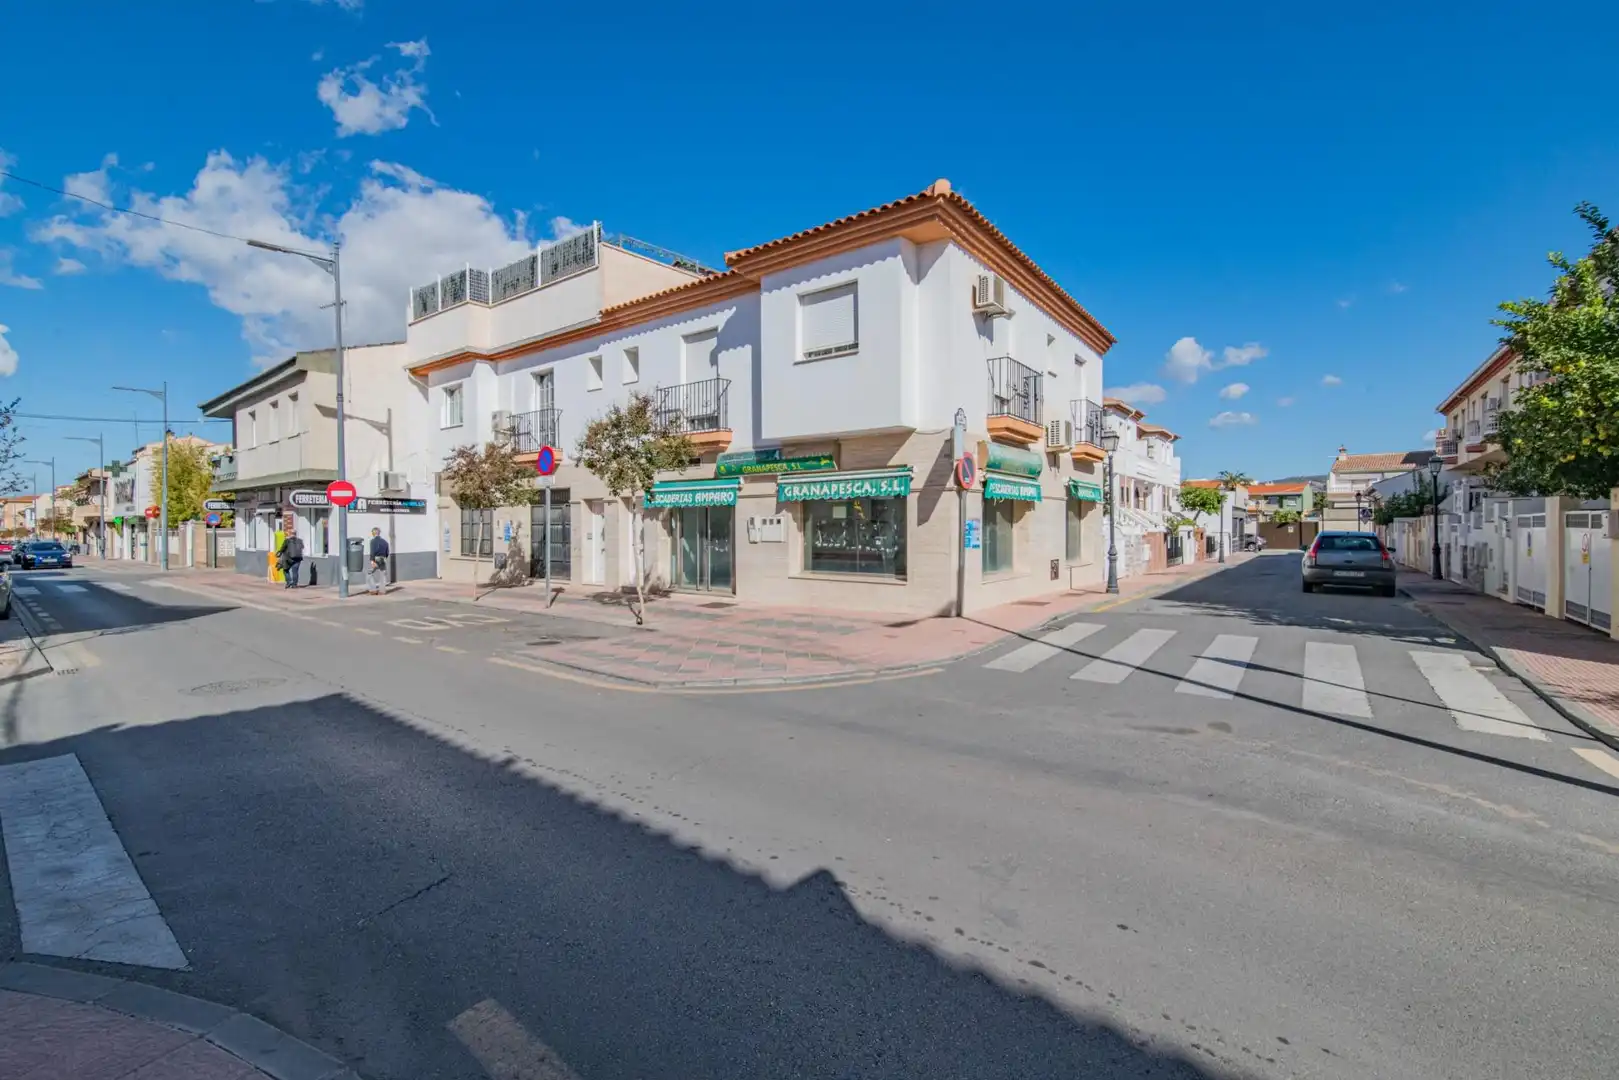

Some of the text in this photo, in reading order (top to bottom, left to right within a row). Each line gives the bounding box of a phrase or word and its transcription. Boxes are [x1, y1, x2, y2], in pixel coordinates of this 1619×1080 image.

[784, 479, 905, 497] GRANAPESCA, S.L.
[649, 489, 734, 504] SCADERIAS AMPARO
